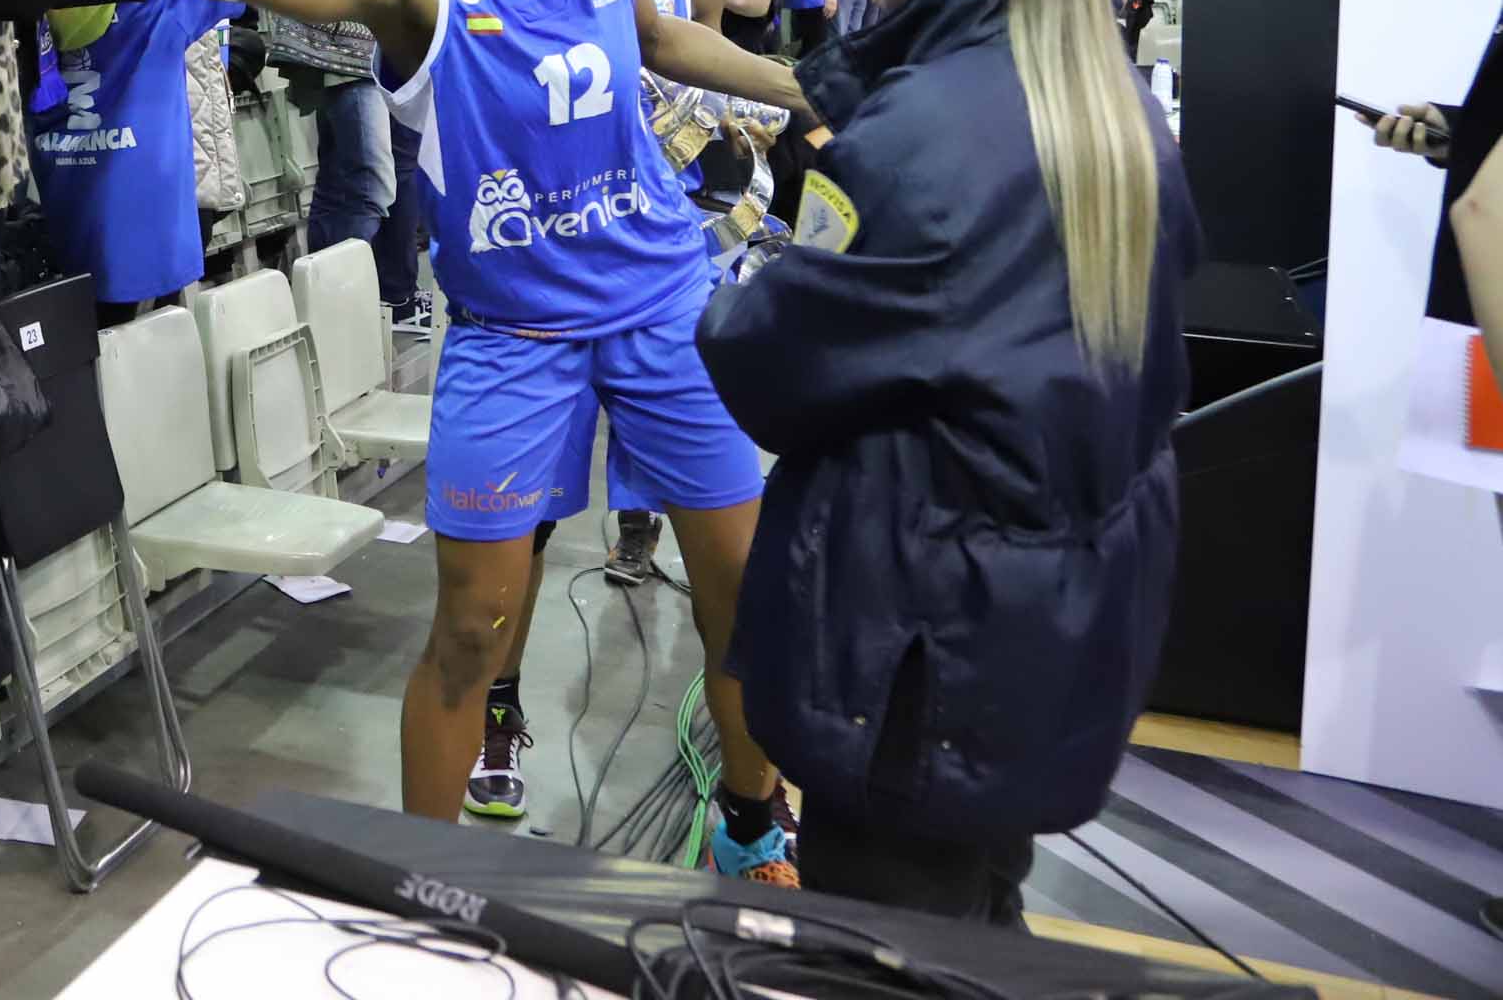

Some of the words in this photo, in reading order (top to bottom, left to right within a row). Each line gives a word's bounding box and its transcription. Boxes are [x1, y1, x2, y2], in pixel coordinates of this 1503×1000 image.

[533, 42, 614, 126] 12
[535, 167, 637, 203] PERFUMERI
[26, 330, 38, 345] 23
